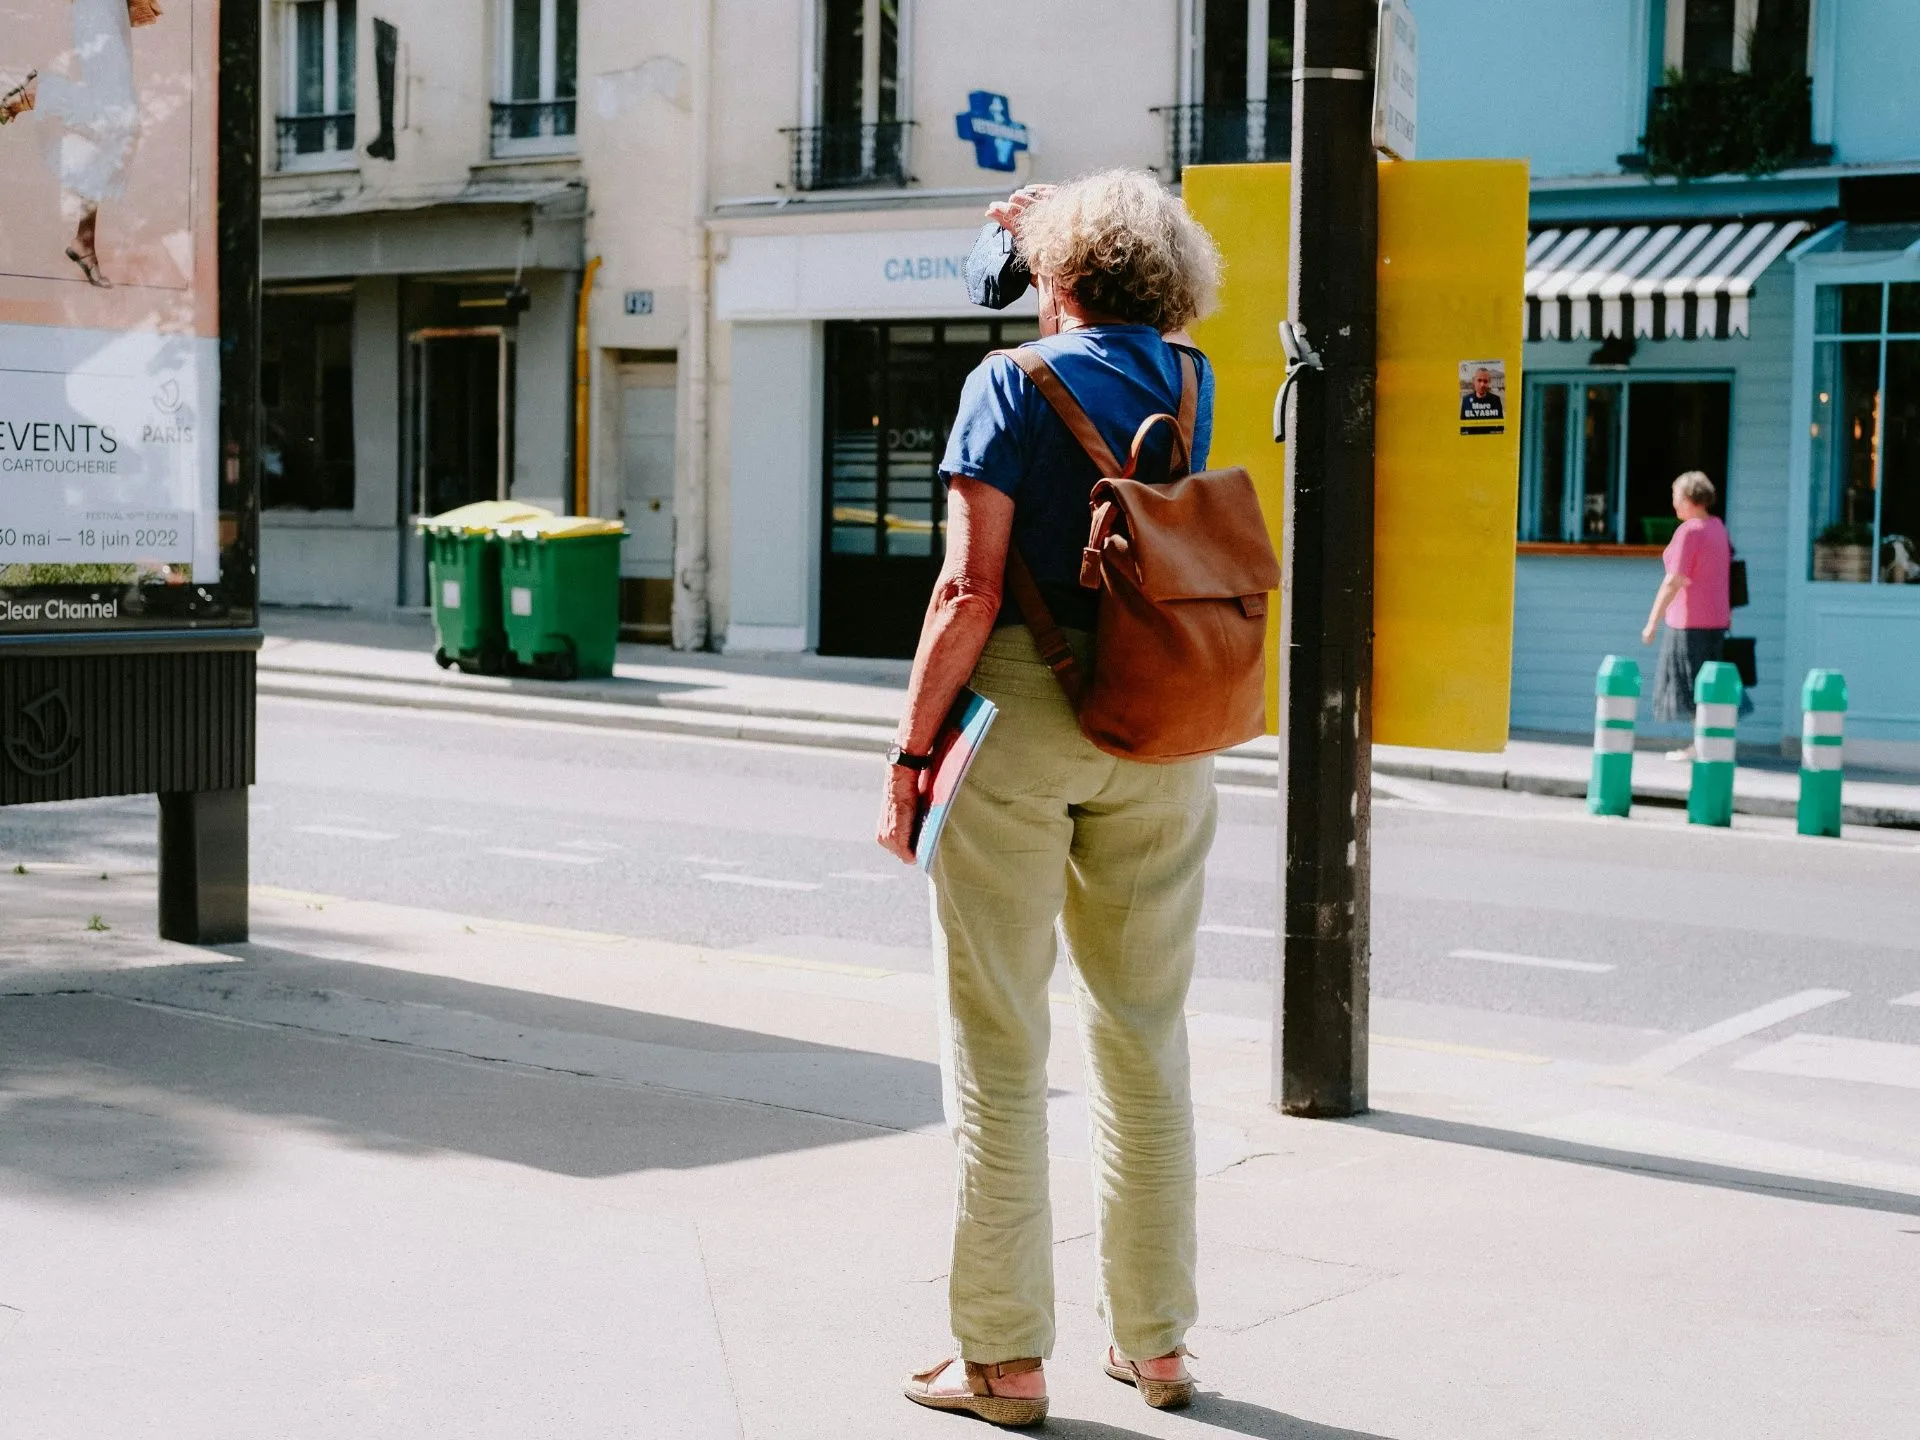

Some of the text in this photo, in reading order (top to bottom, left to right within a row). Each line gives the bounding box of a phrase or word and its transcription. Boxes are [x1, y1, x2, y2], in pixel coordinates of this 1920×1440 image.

[884, 256, 967, 280] CABIN
[143, 424, 193, 443] PARIS
[2, 458, 117, 474] CARTOUCHERIE
[0, 528, 16, 546] 0
[23, 530, 50, 546] mai
[78, 530, 95, 546] 18
[102, 530, 130, 550] juin
[136, 529, 178, 547] 2022
[45, 598, 118, 620] Channel
